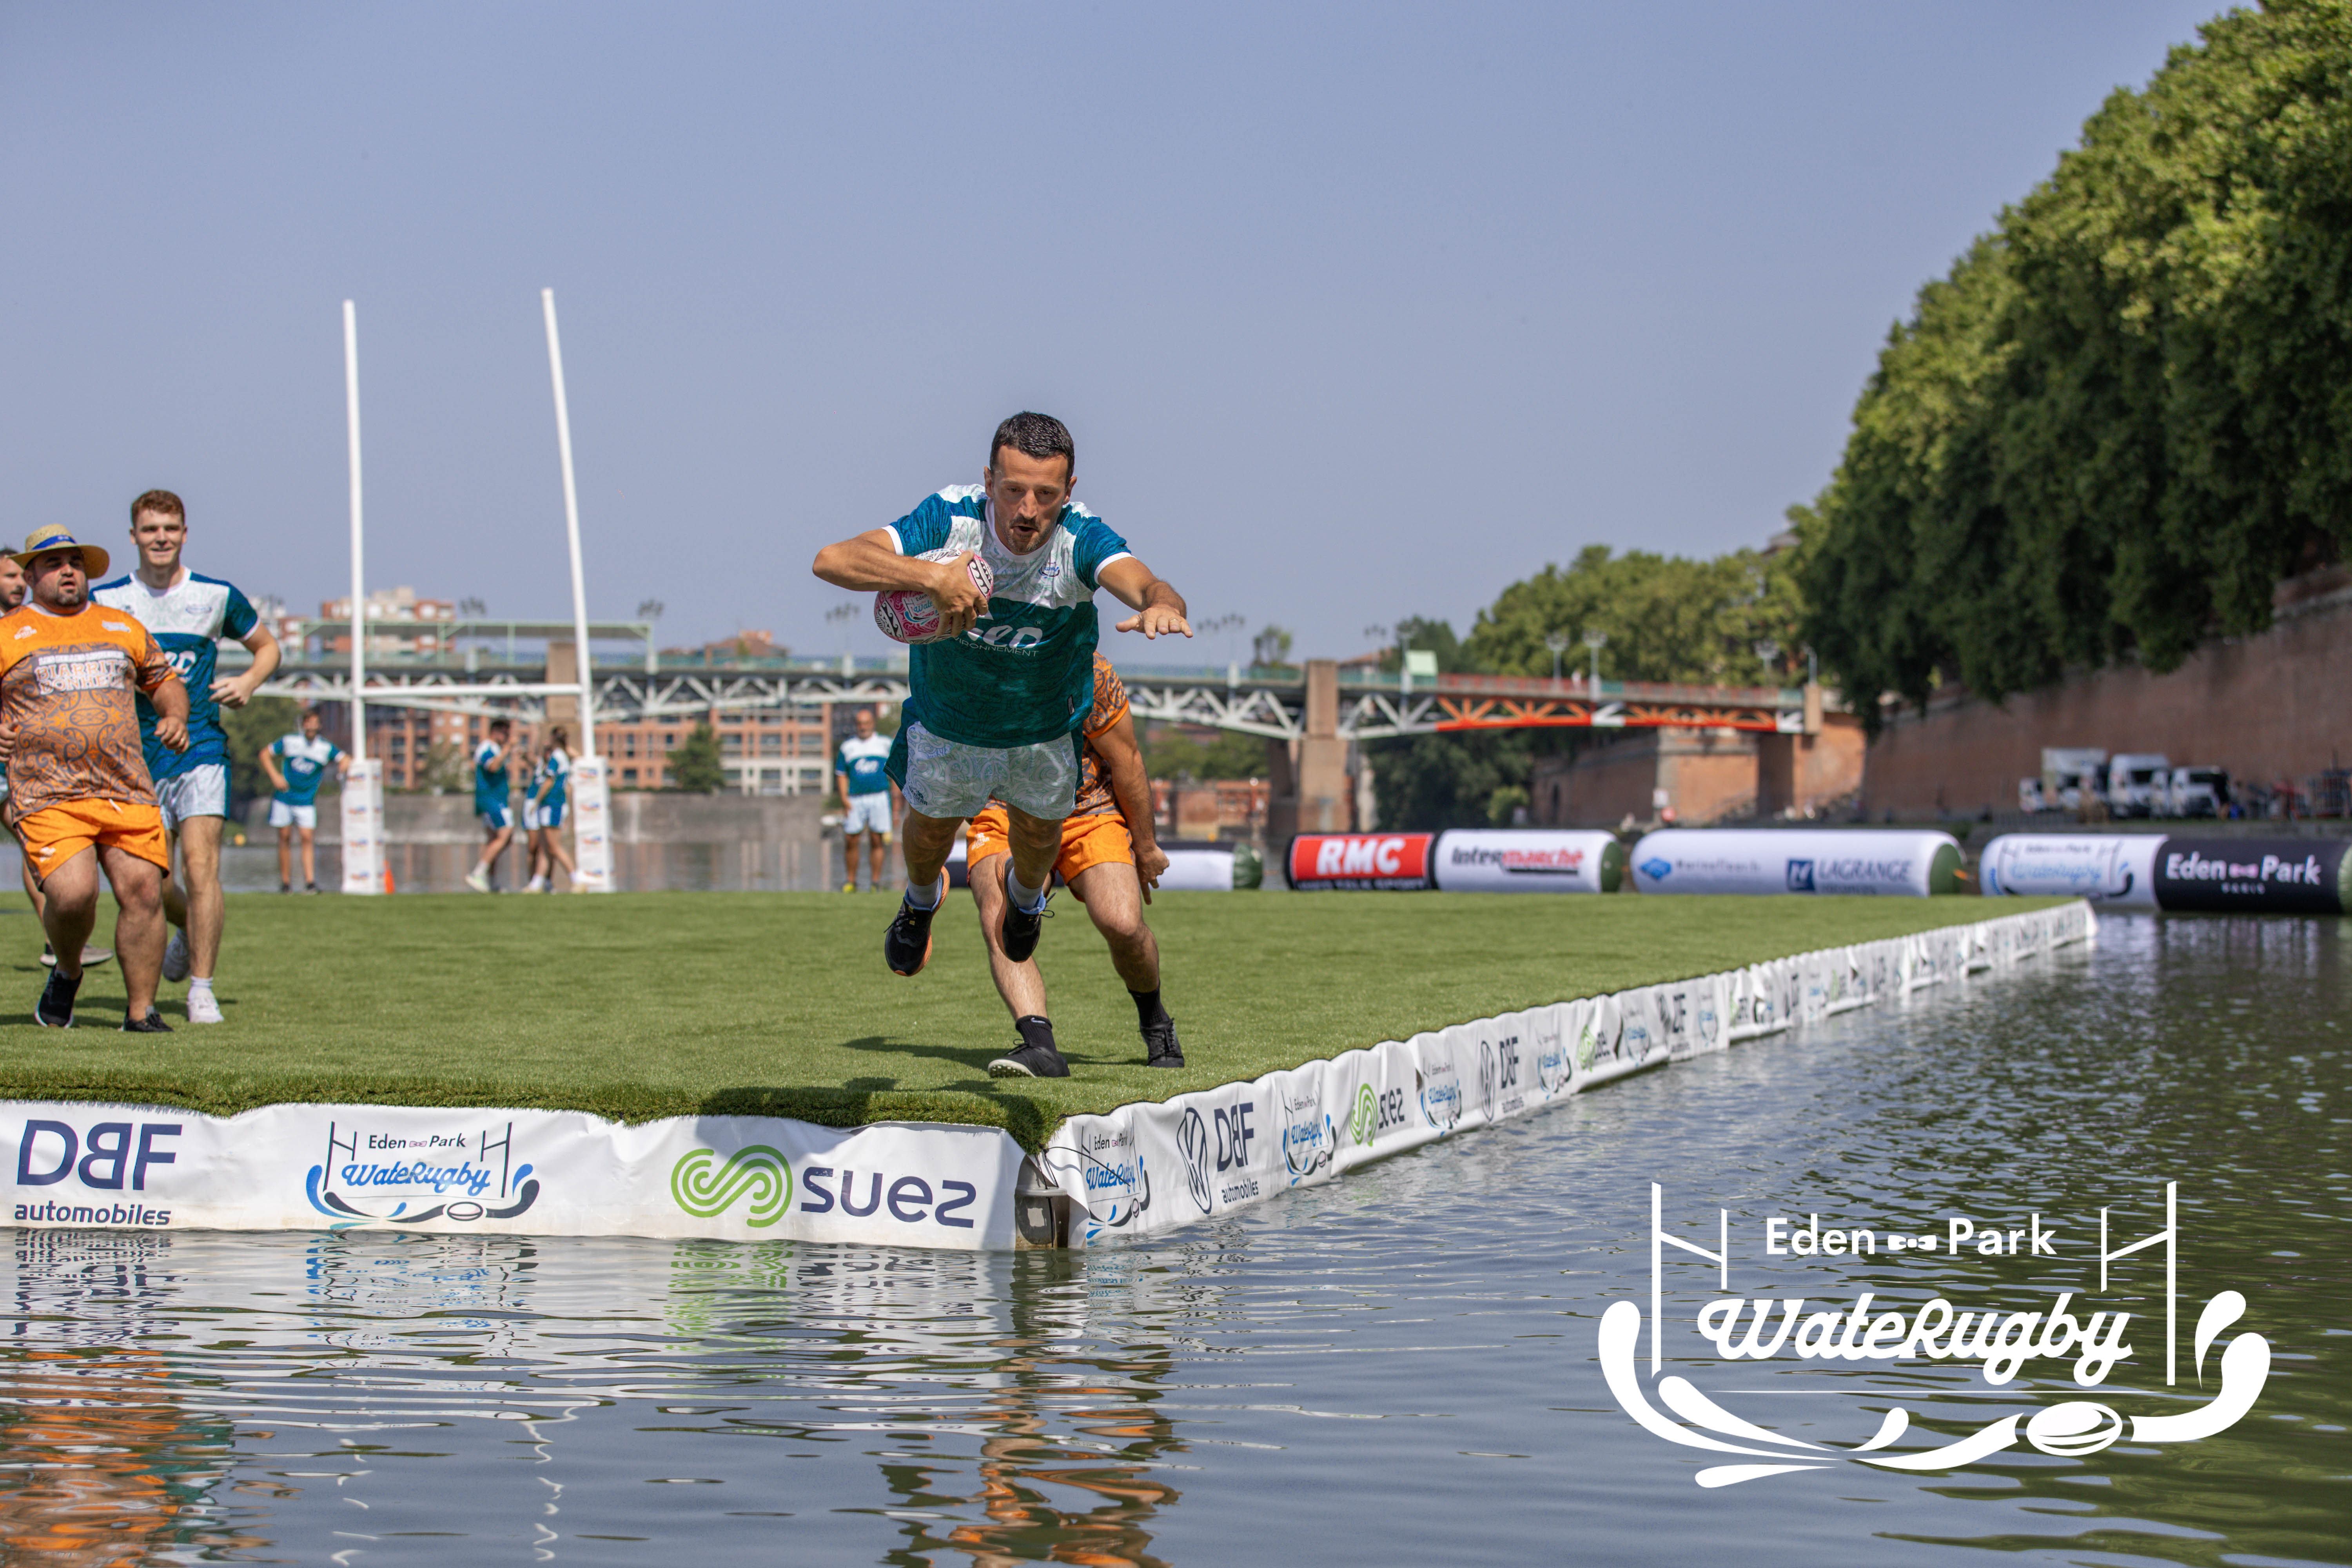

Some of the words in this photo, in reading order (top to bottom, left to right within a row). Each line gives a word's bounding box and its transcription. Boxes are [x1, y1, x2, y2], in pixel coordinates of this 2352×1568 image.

[916, 593, 927, 602] Eden
[954, 637, 1039, 657] VIRONNEMENT
[1316, 838, 1405, 876] RMC
[2165, 851, 2226, 881] Eden
[2260, 854, 2322, 886] Park
[369, 1133, 407, 1149] Eden
[429, 1132, 466, 1147] Park
[1094, 1134, 1110, 1151] Eden
[1119, 1131, 1128, 1147] Park
[16, 1119, 183, 1191] DBF
[1221, 1178, 1259, 1204] automobiles
[14, 1200, 171, 1226] automobiles
